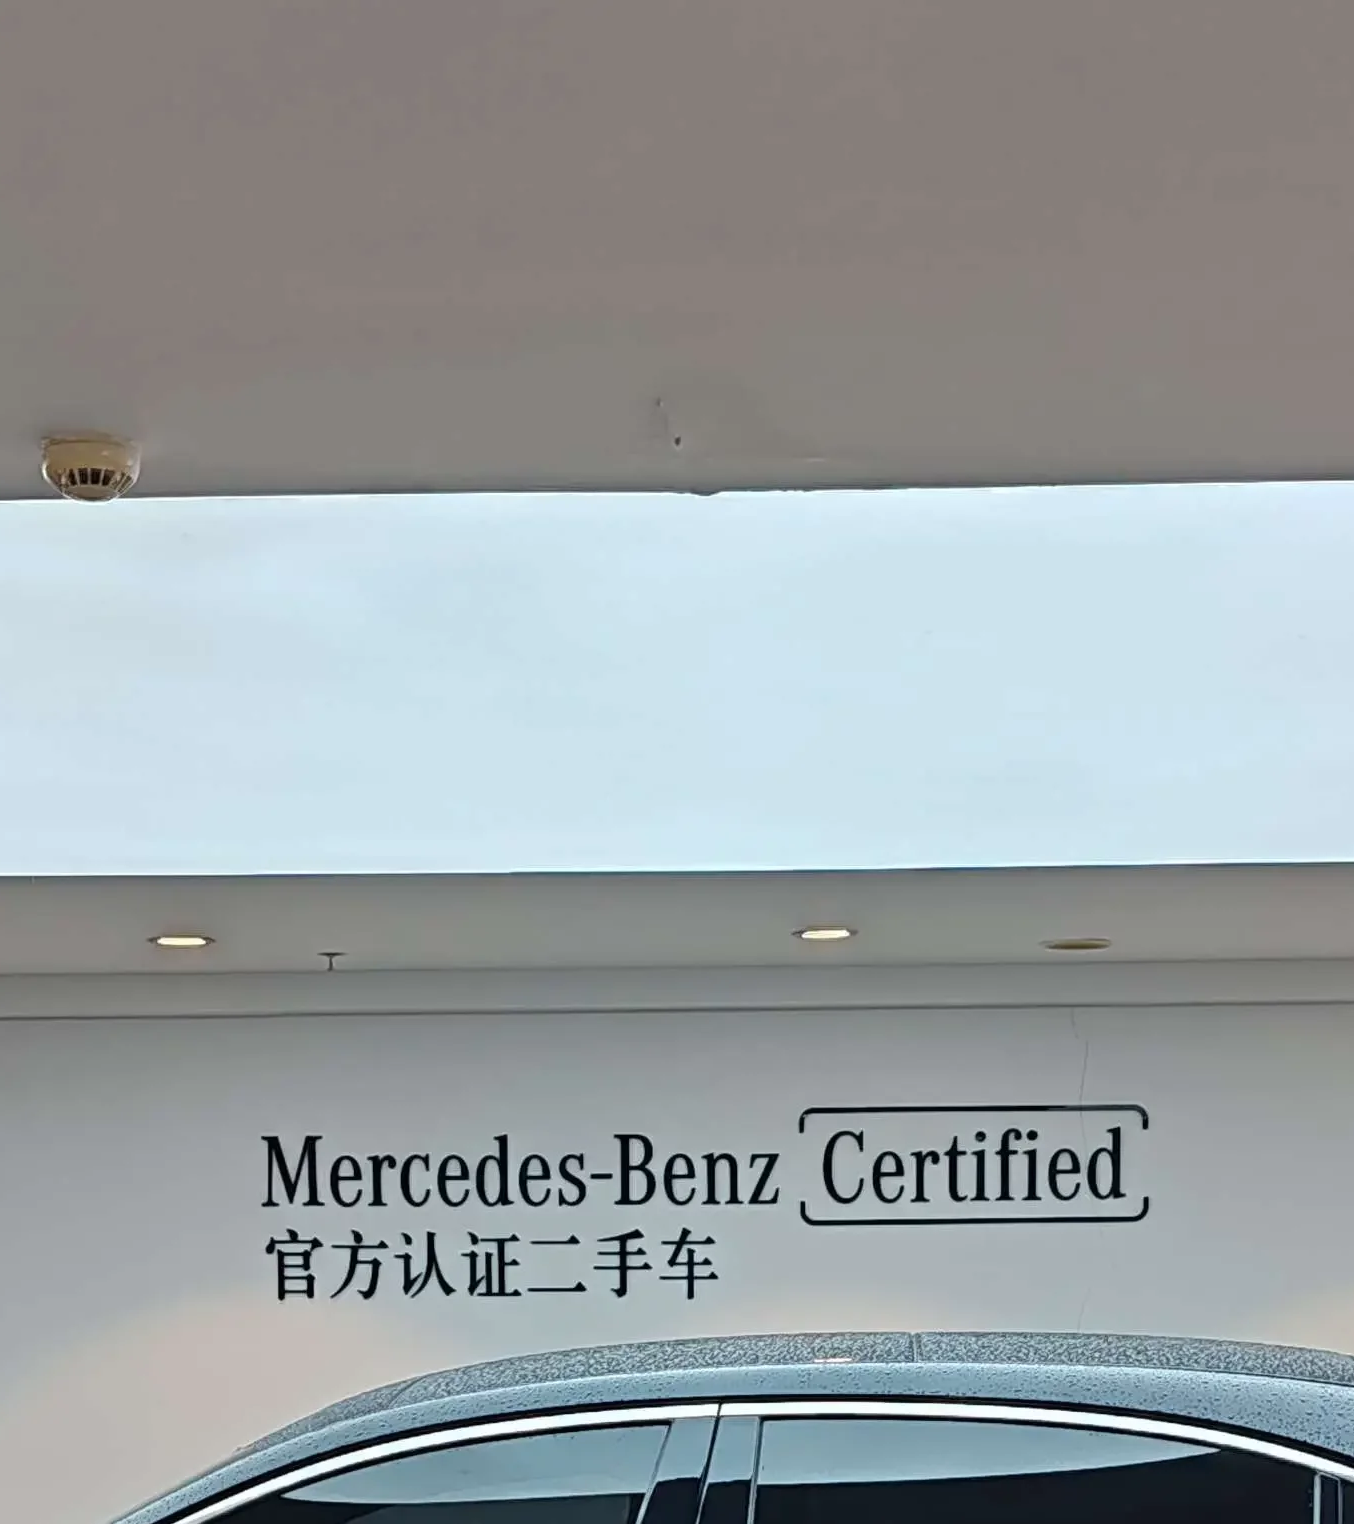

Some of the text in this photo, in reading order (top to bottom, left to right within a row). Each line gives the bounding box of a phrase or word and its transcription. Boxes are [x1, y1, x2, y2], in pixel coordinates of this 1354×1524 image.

[260, 1126, 1128, 1209] Mercedes-Benz Certified
[264, 1227, 720, 1302] 官方认证二手车
